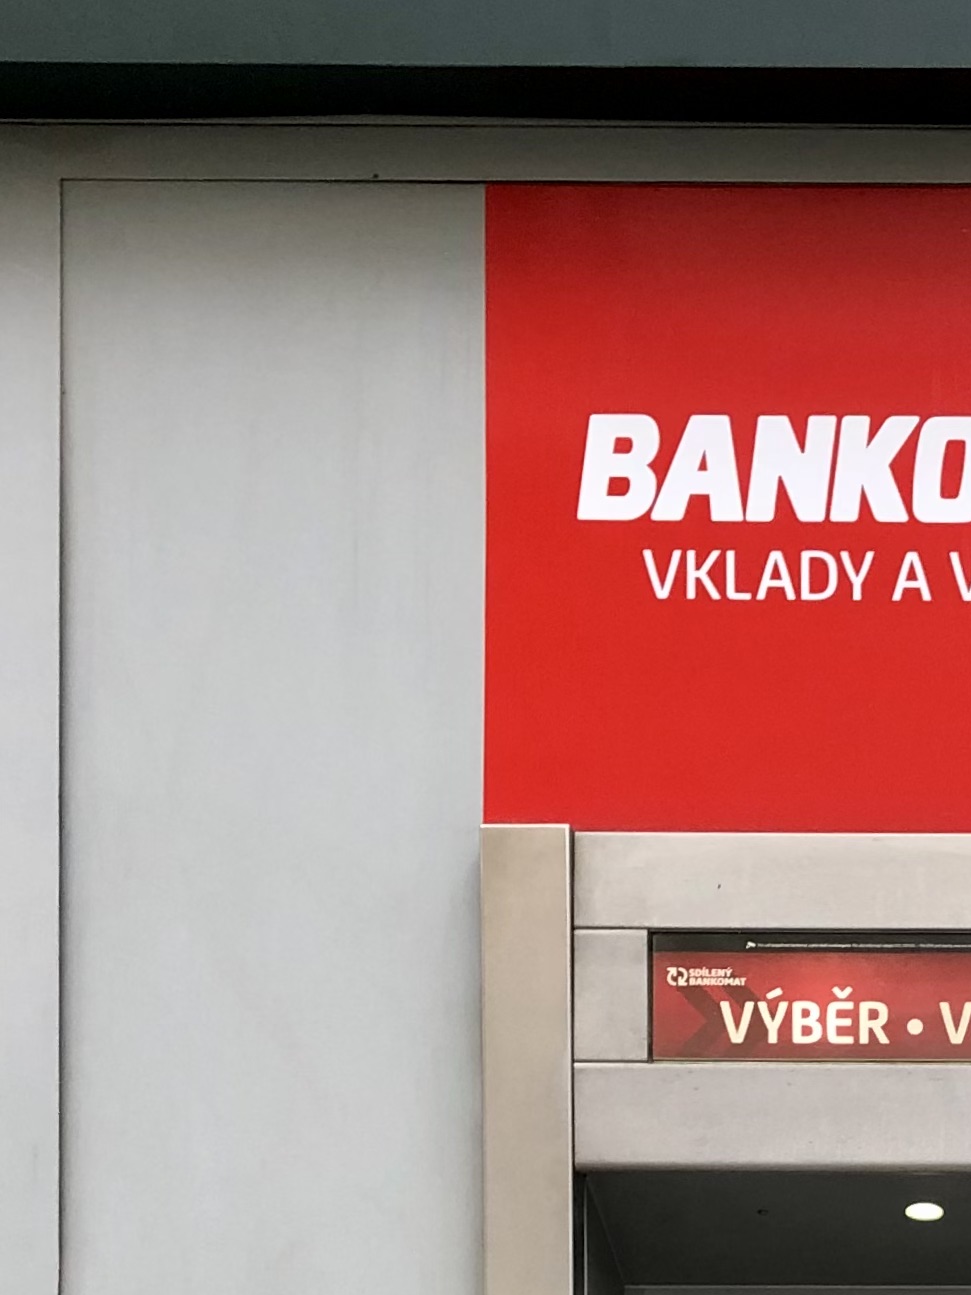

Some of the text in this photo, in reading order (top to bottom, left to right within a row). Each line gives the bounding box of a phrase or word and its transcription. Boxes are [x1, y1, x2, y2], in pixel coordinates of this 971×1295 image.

[642, 548, 874, 601] VKLADY
[892, 549, 931, 602] A
[688, 966, 733, 978] SDÍLENÝ
[688, 977, 747, 987] BANKOMAT
[719, 986, 890, 1045] VÝBĚR
